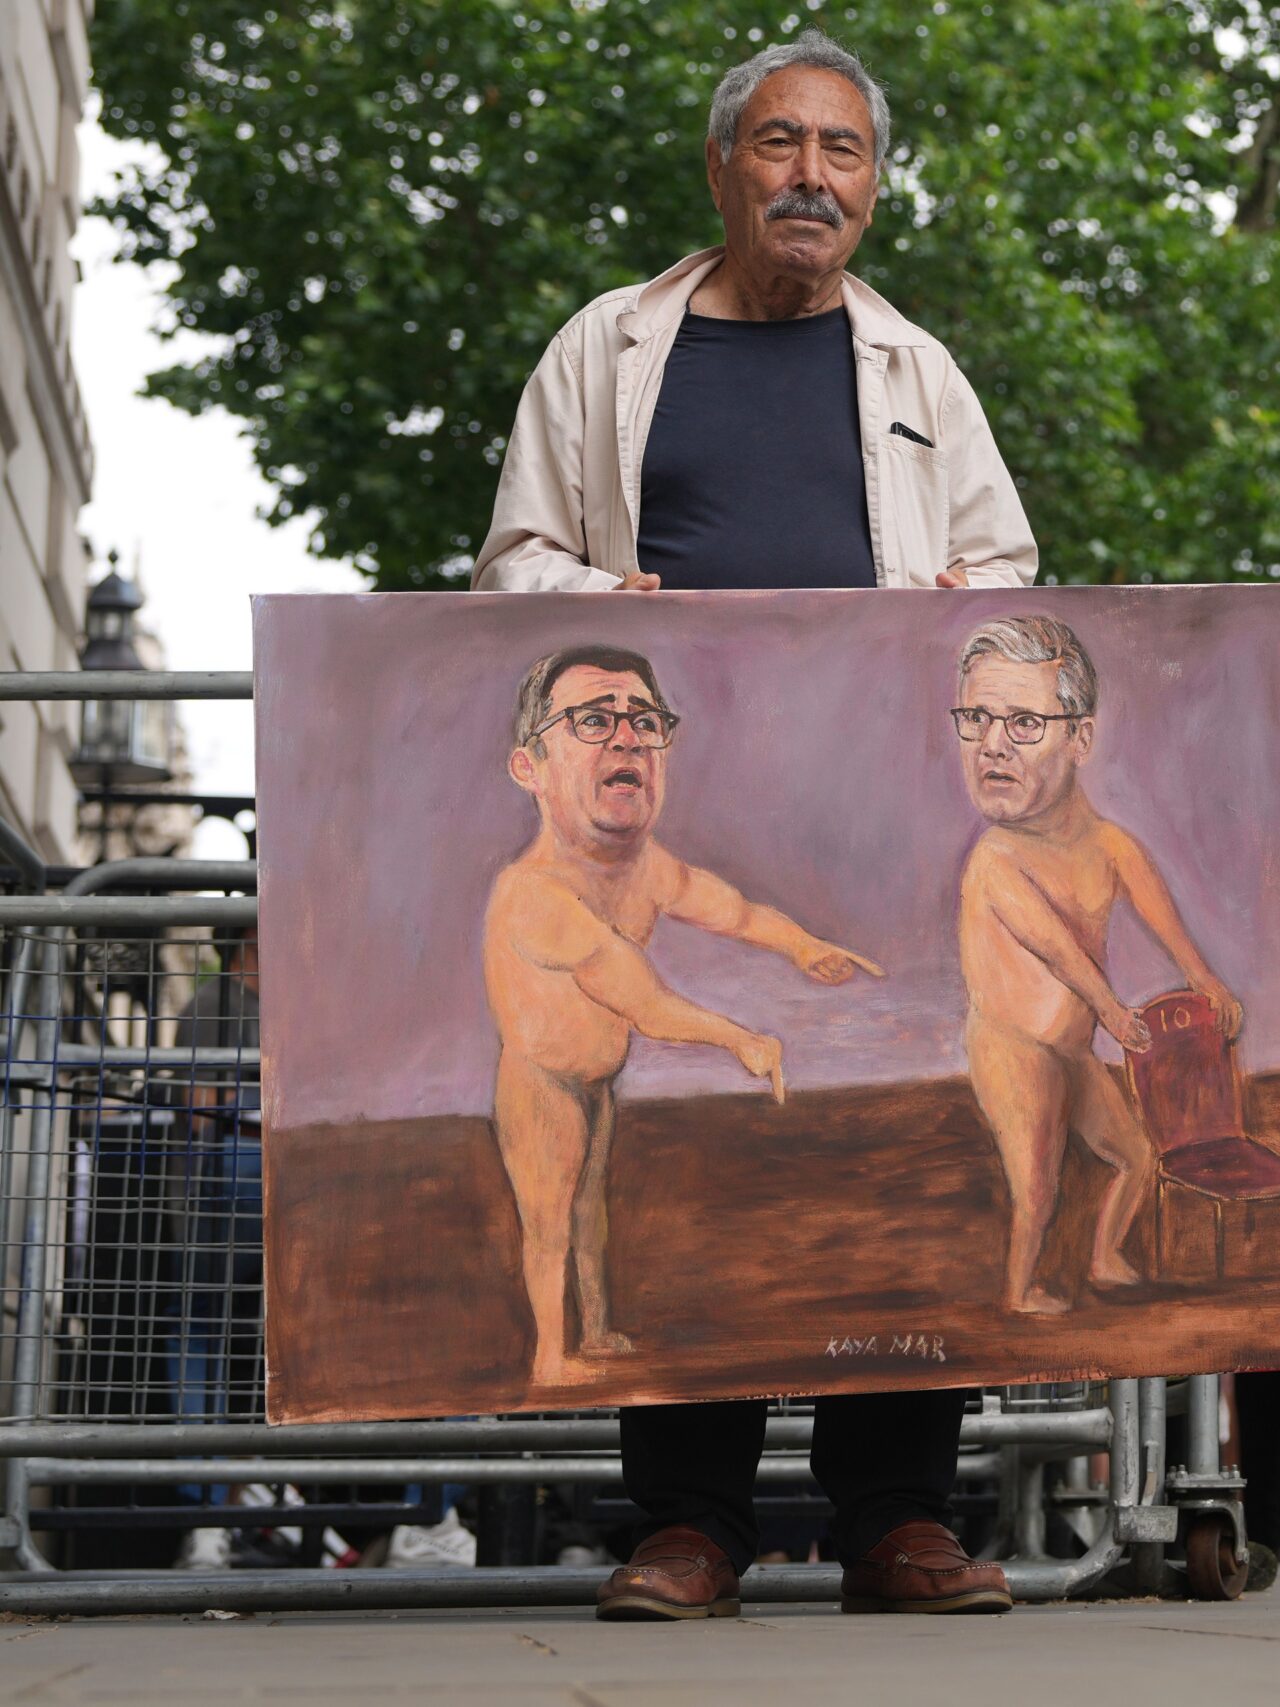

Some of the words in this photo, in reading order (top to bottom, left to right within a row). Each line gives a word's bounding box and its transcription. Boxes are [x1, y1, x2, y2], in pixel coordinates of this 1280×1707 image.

[1160, 1007, 1191, 1033] 10
[825, 1335, 879, 1358] KAYA
[889, 1333, 946, 1362] MAR
